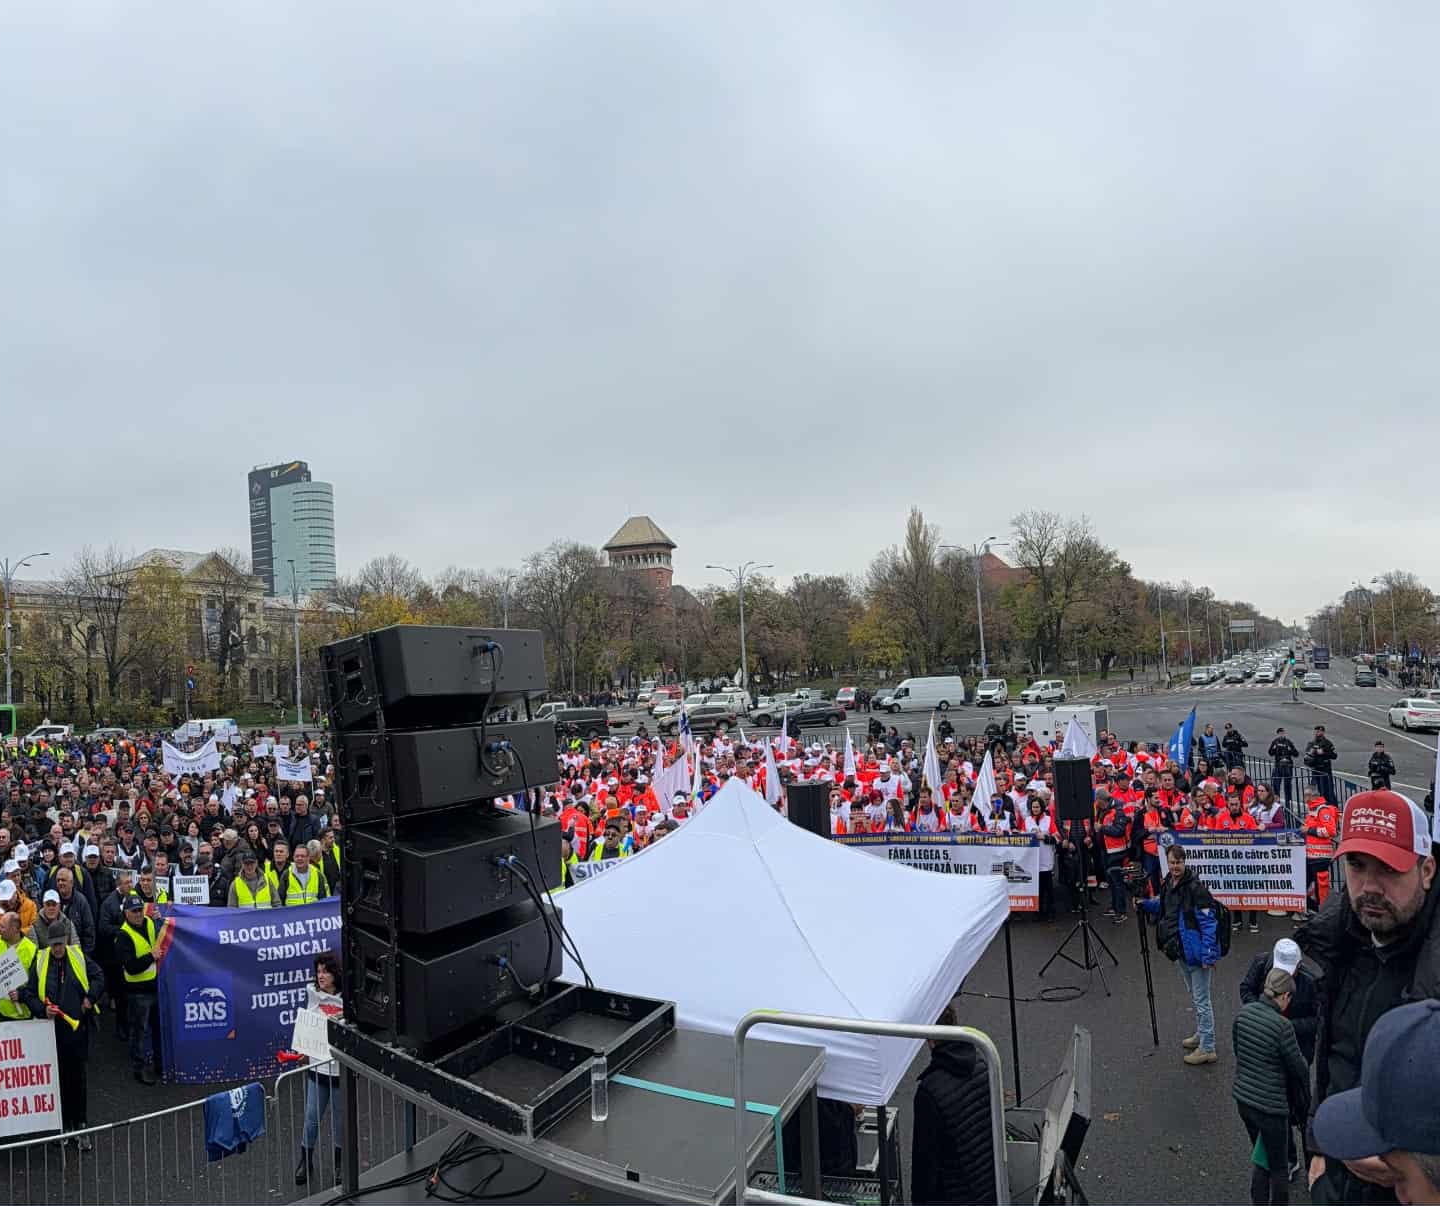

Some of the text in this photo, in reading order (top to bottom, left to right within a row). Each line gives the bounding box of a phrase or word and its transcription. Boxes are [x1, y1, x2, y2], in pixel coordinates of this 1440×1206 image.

[1351, 807, 1398, 822] ORACLE
[914, 848, 940, 860] LEGEA
[1231, 848, 1243, 859] de
[1271, 848, 1292, 859] STAT
[1236, 864, 1292, 875] ECHIPAJELOR
[218, 925, 281, 944] BLOCUL
[257, 939, 331, 961] SINDICAL
[184, 1002, 227, 1022] BNS
[12, 1095, 33, 1116] S.A.
[33, 1093, 55, 1113] DEJ
